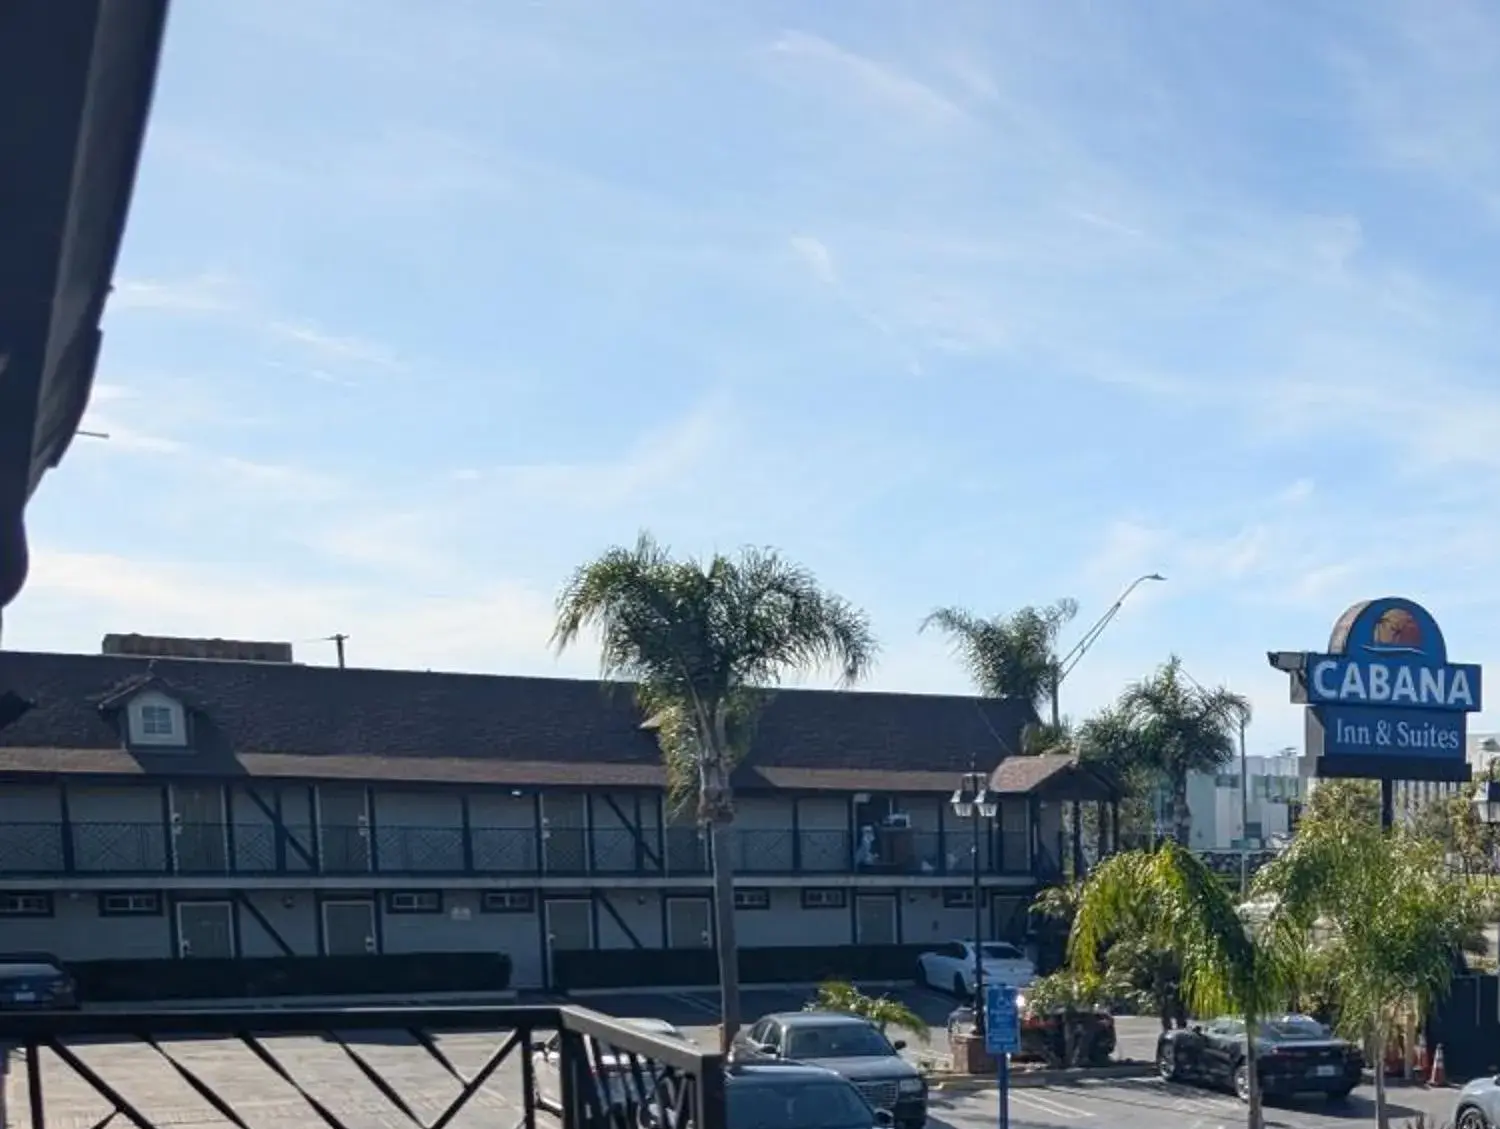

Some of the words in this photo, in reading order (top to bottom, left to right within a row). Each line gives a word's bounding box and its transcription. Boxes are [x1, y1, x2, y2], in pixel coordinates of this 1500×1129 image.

[1313, 660, 1473, 705] CABANA
[1336, 719, 1371, 745] Inn
[1375, 719, 1392, 745] &
[1396, 721, 1459, 749] Suites
